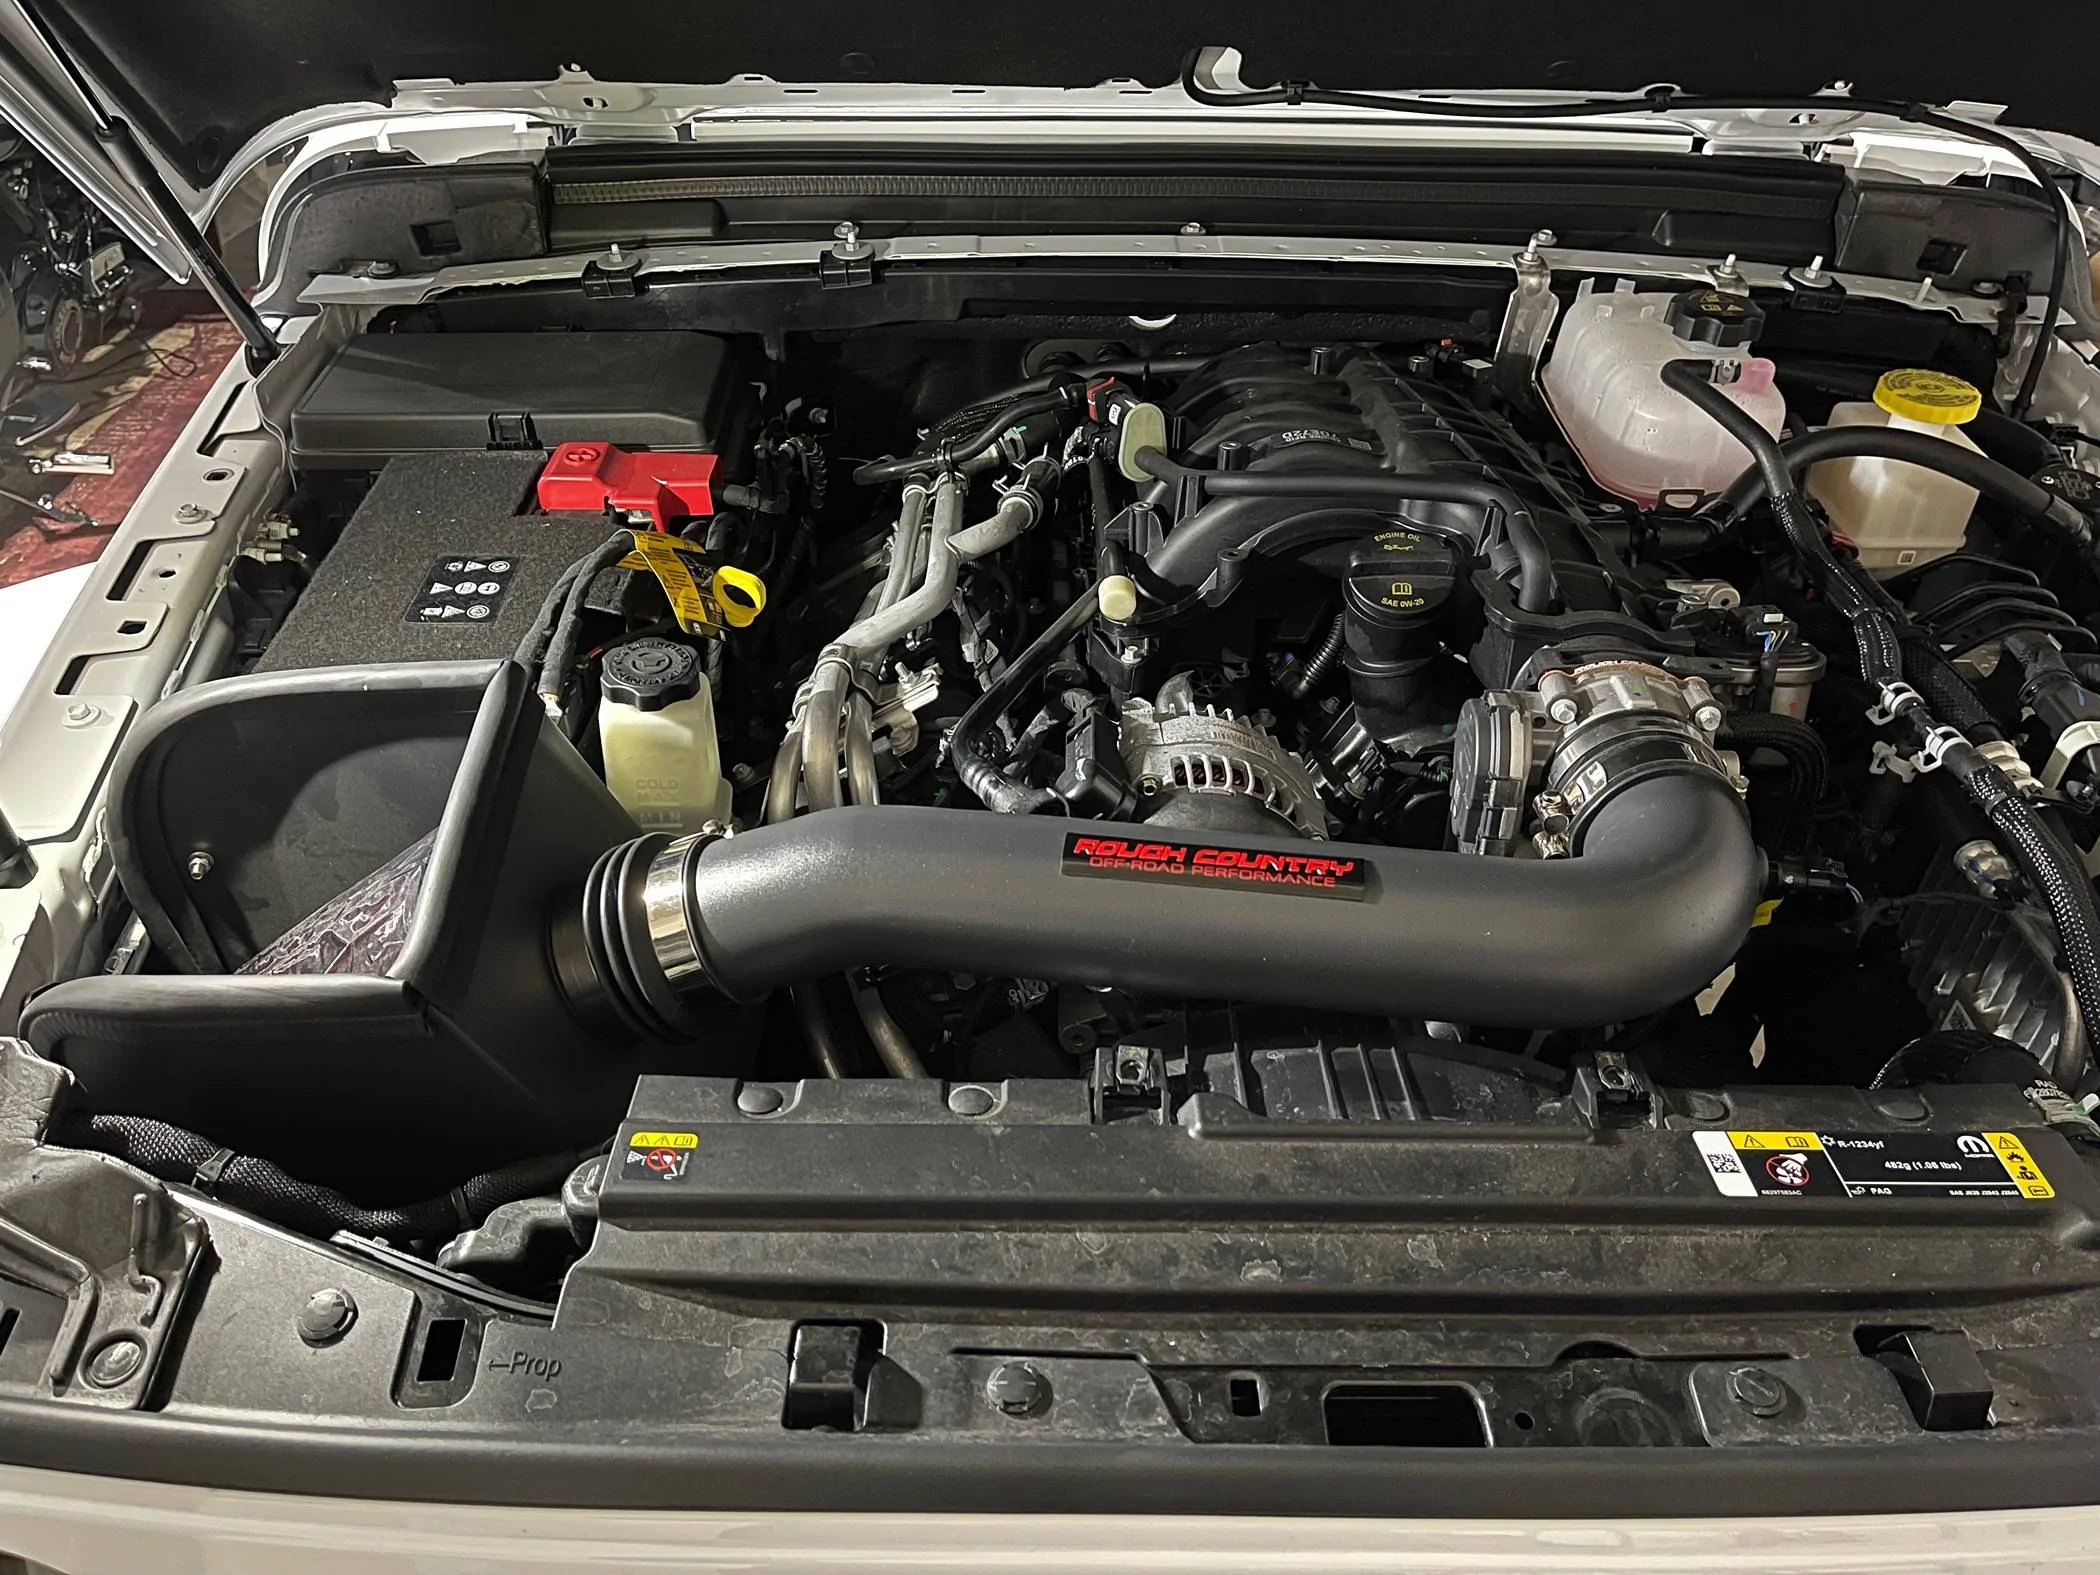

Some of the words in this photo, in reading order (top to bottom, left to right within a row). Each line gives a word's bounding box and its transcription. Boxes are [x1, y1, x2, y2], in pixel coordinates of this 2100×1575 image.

[1374, 531, 1406, 542] ENGINE
[1407, 533, 1421, 542] OIL
[1381, 597, 1398, 607] SAE
[1400, 598, 1424, 608] 0W-20
[636, 778, 679, 790] COLD
[1073, 837, 1188, 863] ROUGH
[1193, 848, 1354, 877] COUNTRY
[1191, 864, 1336, 888] PERFORMANCE
[509, 1350, 562, 1383] Prop
